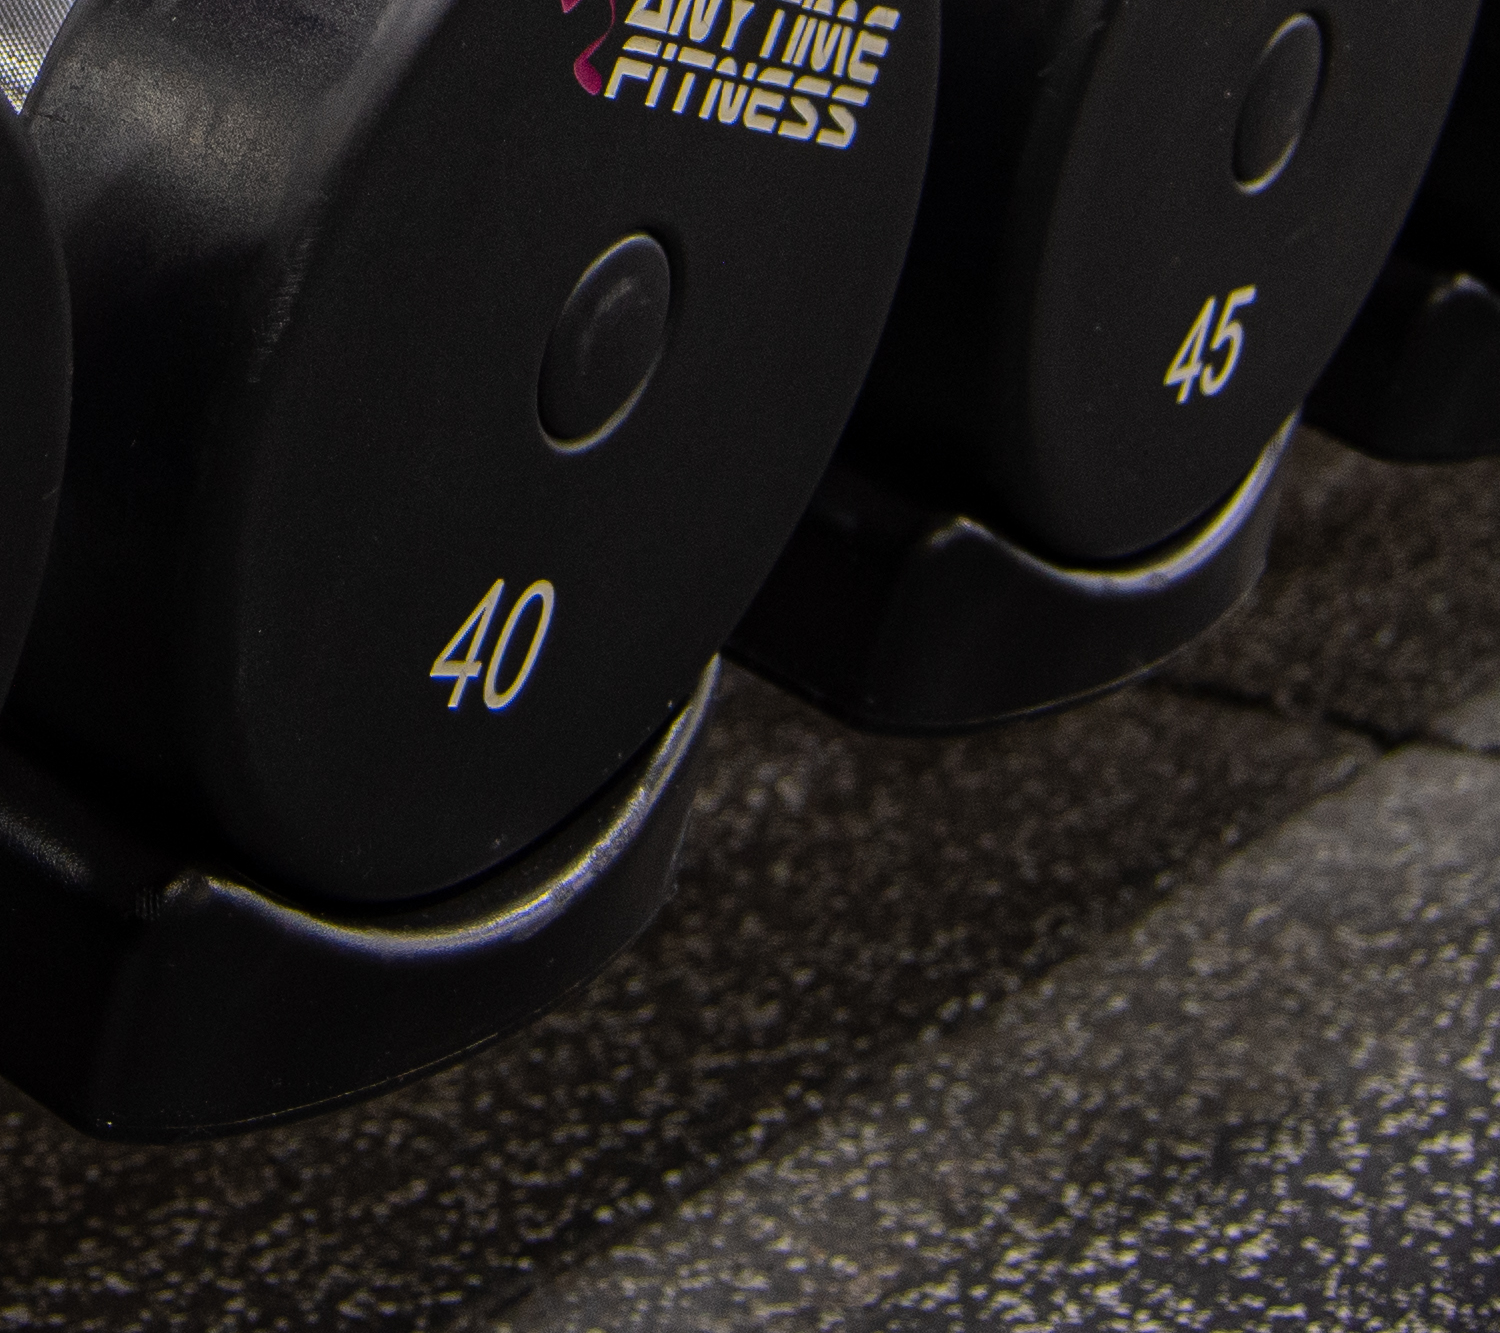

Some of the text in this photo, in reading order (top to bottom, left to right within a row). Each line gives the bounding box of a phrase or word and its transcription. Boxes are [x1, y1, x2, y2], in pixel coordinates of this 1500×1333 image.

[603, 35, 870, 150] FITNESS
[1163, 285, 1256, 403] 45
[428, 577, 556, 711] 40
